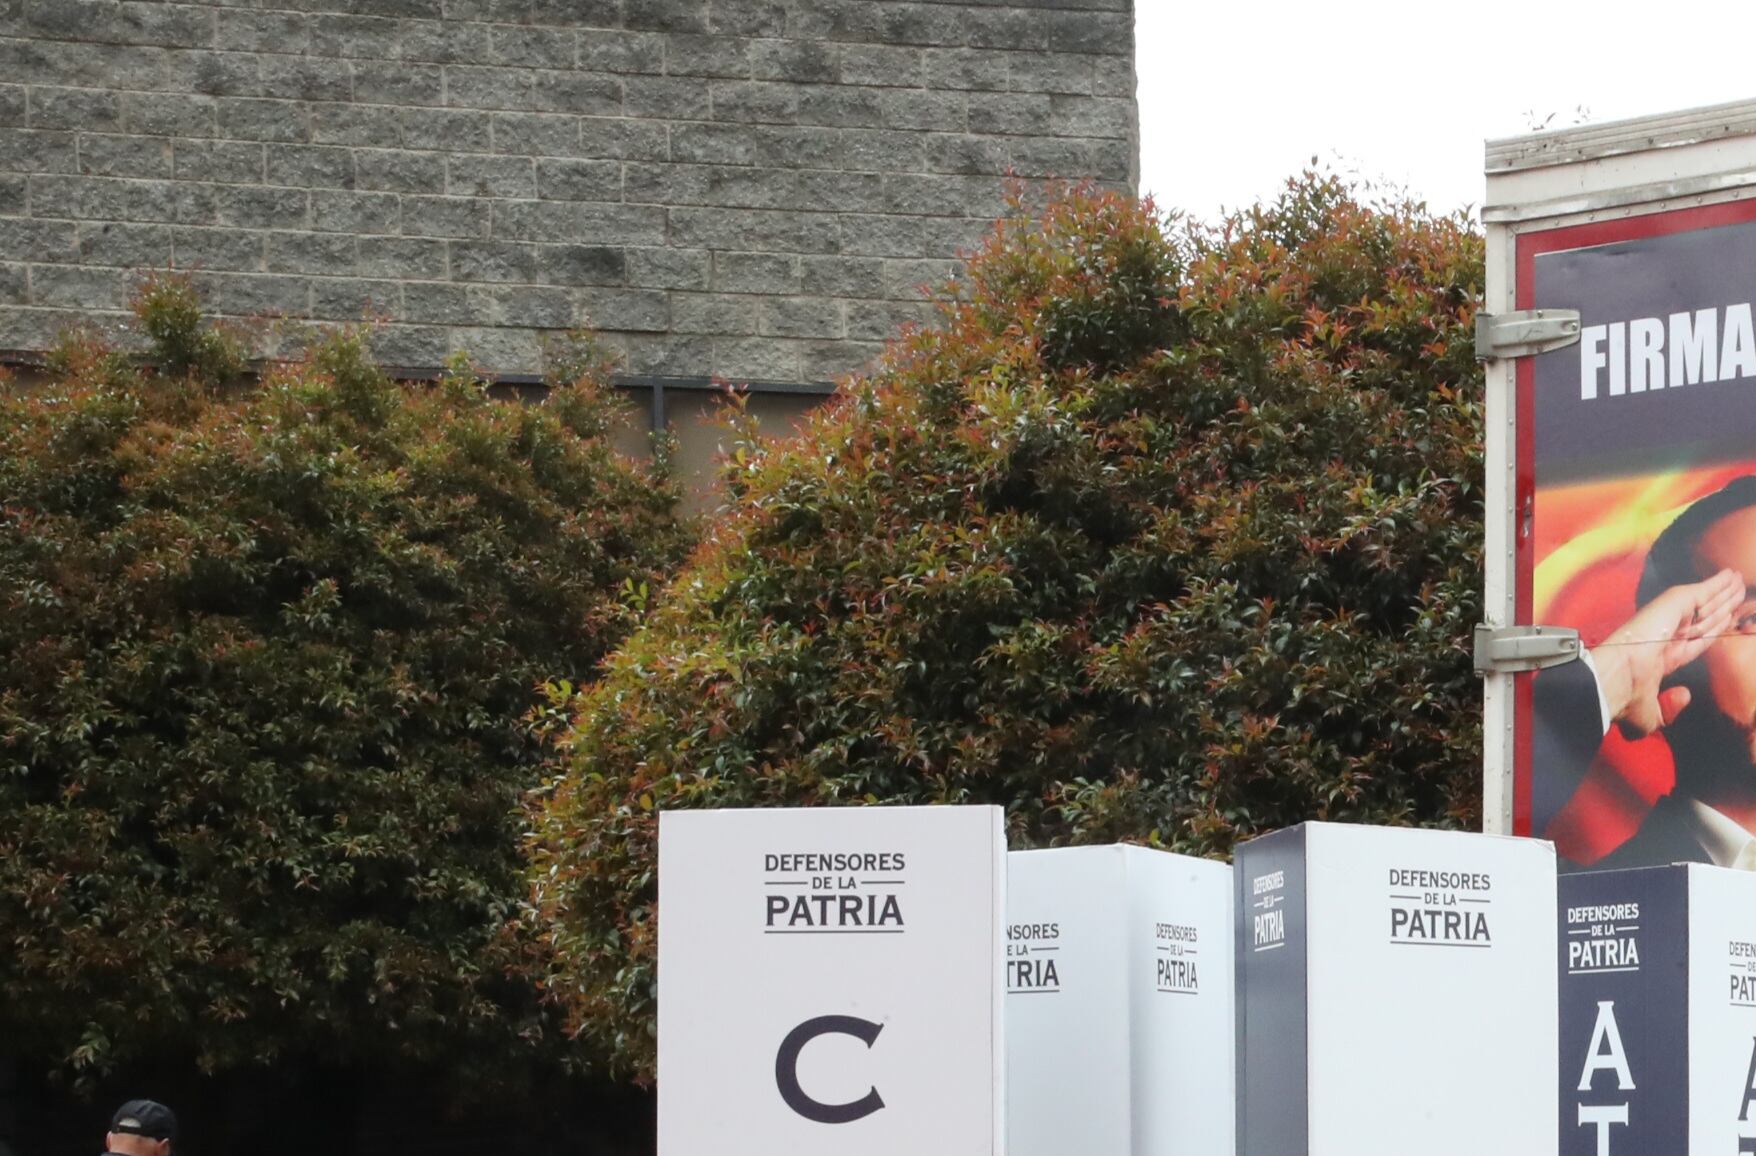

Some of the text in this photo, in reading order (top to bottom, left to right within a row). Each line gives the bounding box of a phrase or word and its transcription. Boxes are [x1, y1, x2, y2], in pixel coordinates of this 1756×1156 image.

[765, 853, 905, 872] DEFENSORES
[812, 877, 857, 889] DE LA
[1254, 870, 1284, 895] DEFENSORES
[1389, 869, 1491, 890] DEFENSORES
[1424, 892, 1457, 906] DE LA
[766, 895, 904, 926] PATRIA
[1568, 903, 1639, 923] DEFENSORES
[1007, 923, 1059, 940] NSORES
[1156, 923, 1197, 942] DEFENSORES
[1254, 910, 1285, 945] PATRIA
[1390, 908, 1491, 941] PATRIA
[1591, 924, 1615, 936] DE LA
[1016, 945, 1028, 956] LA
[1170, 945, 1177, 955] DE
[1569, 938, 1639, 967] PATRIA
[1007, 959, 1060, 987] TRIA
[1157, 958, 1198, 989] PATRIA
[1747, 961, 1756, 972] DE
